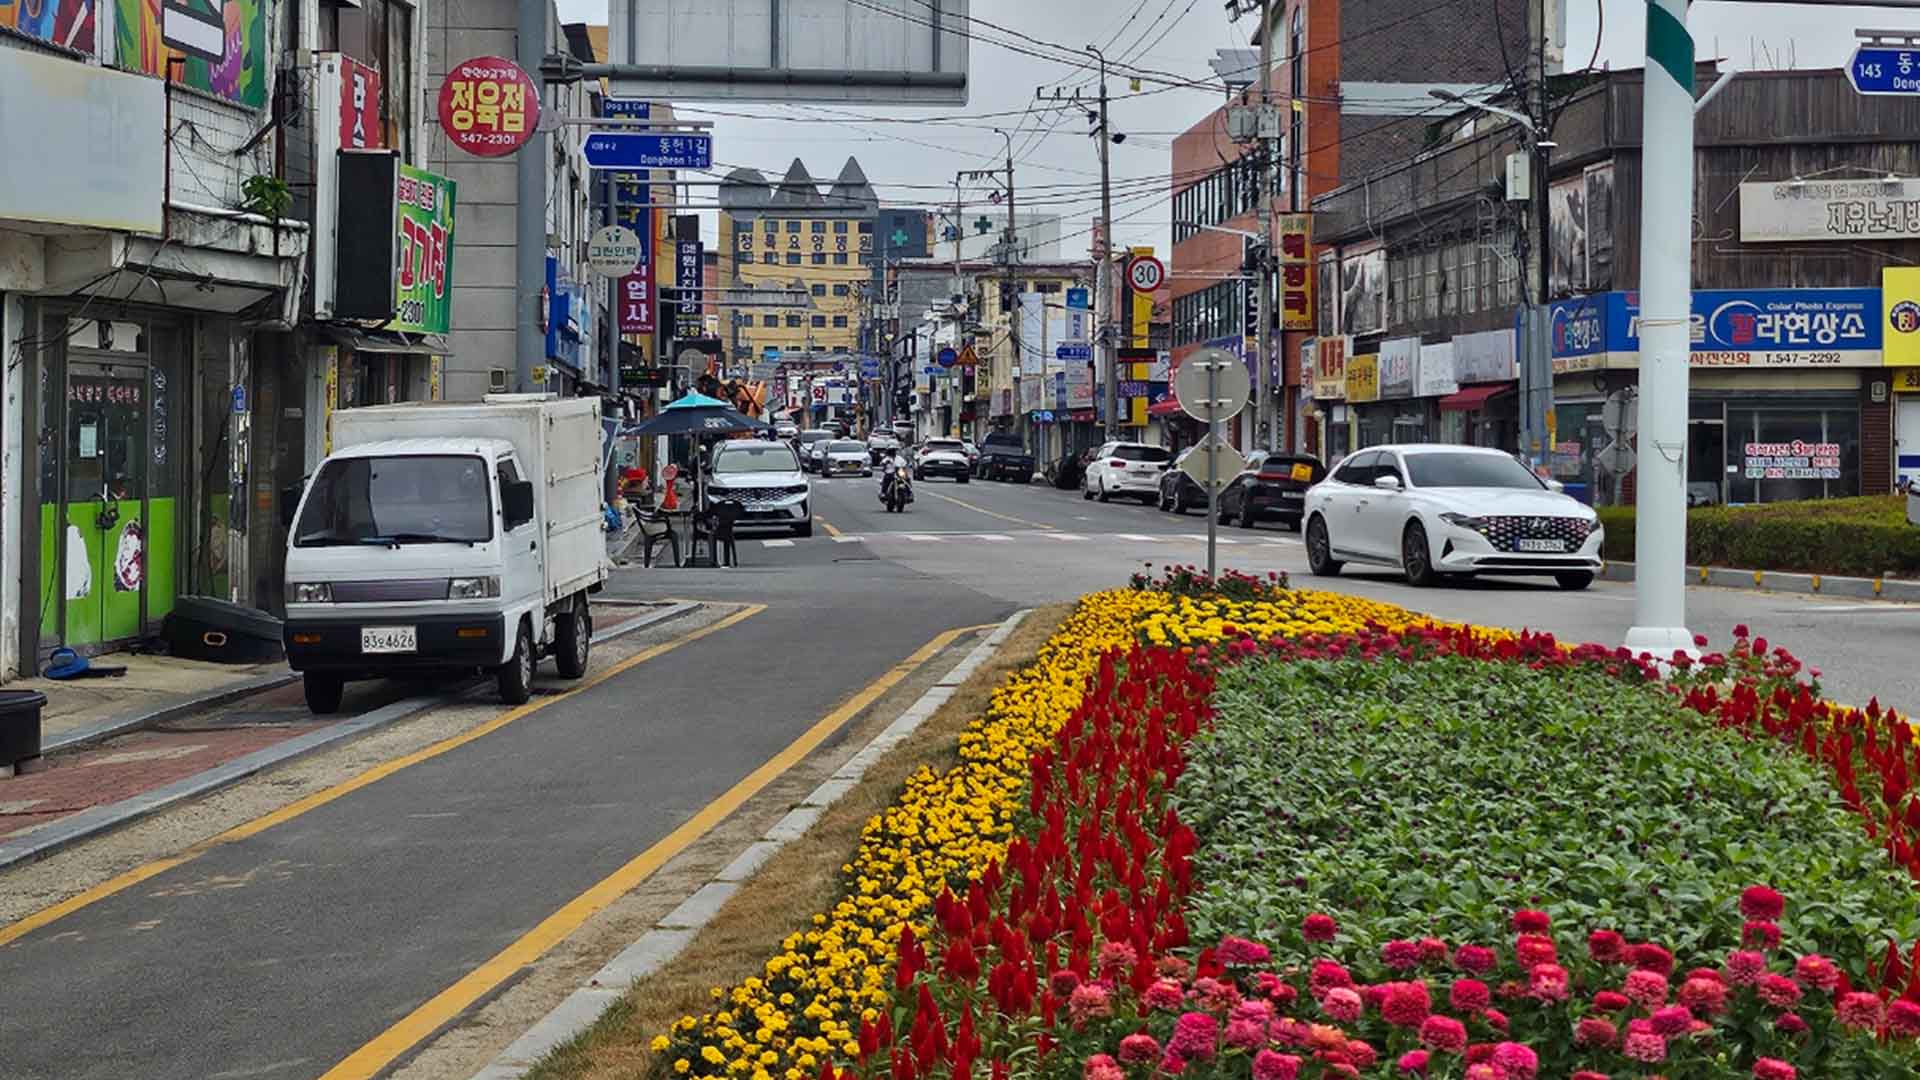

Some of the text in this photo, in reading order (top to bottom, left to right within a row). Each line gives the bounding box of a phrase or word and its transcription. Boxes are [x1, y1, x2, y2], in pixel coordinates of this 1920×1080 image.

[1898, 53, 1920, 74] 동
[1859, 64, 1882, 78] 143
[451, 81, 525, 132] 정육점
[606, 103, 622, 111] Dog
[461, 133, 516, 145] 547-2301
[641, 154, 685, 166] Dongheon
[1135, 265, 1157, 284] 30
[1795, 302, 1823, 310] Photo
[1825, 302, 1865, 312] Express
